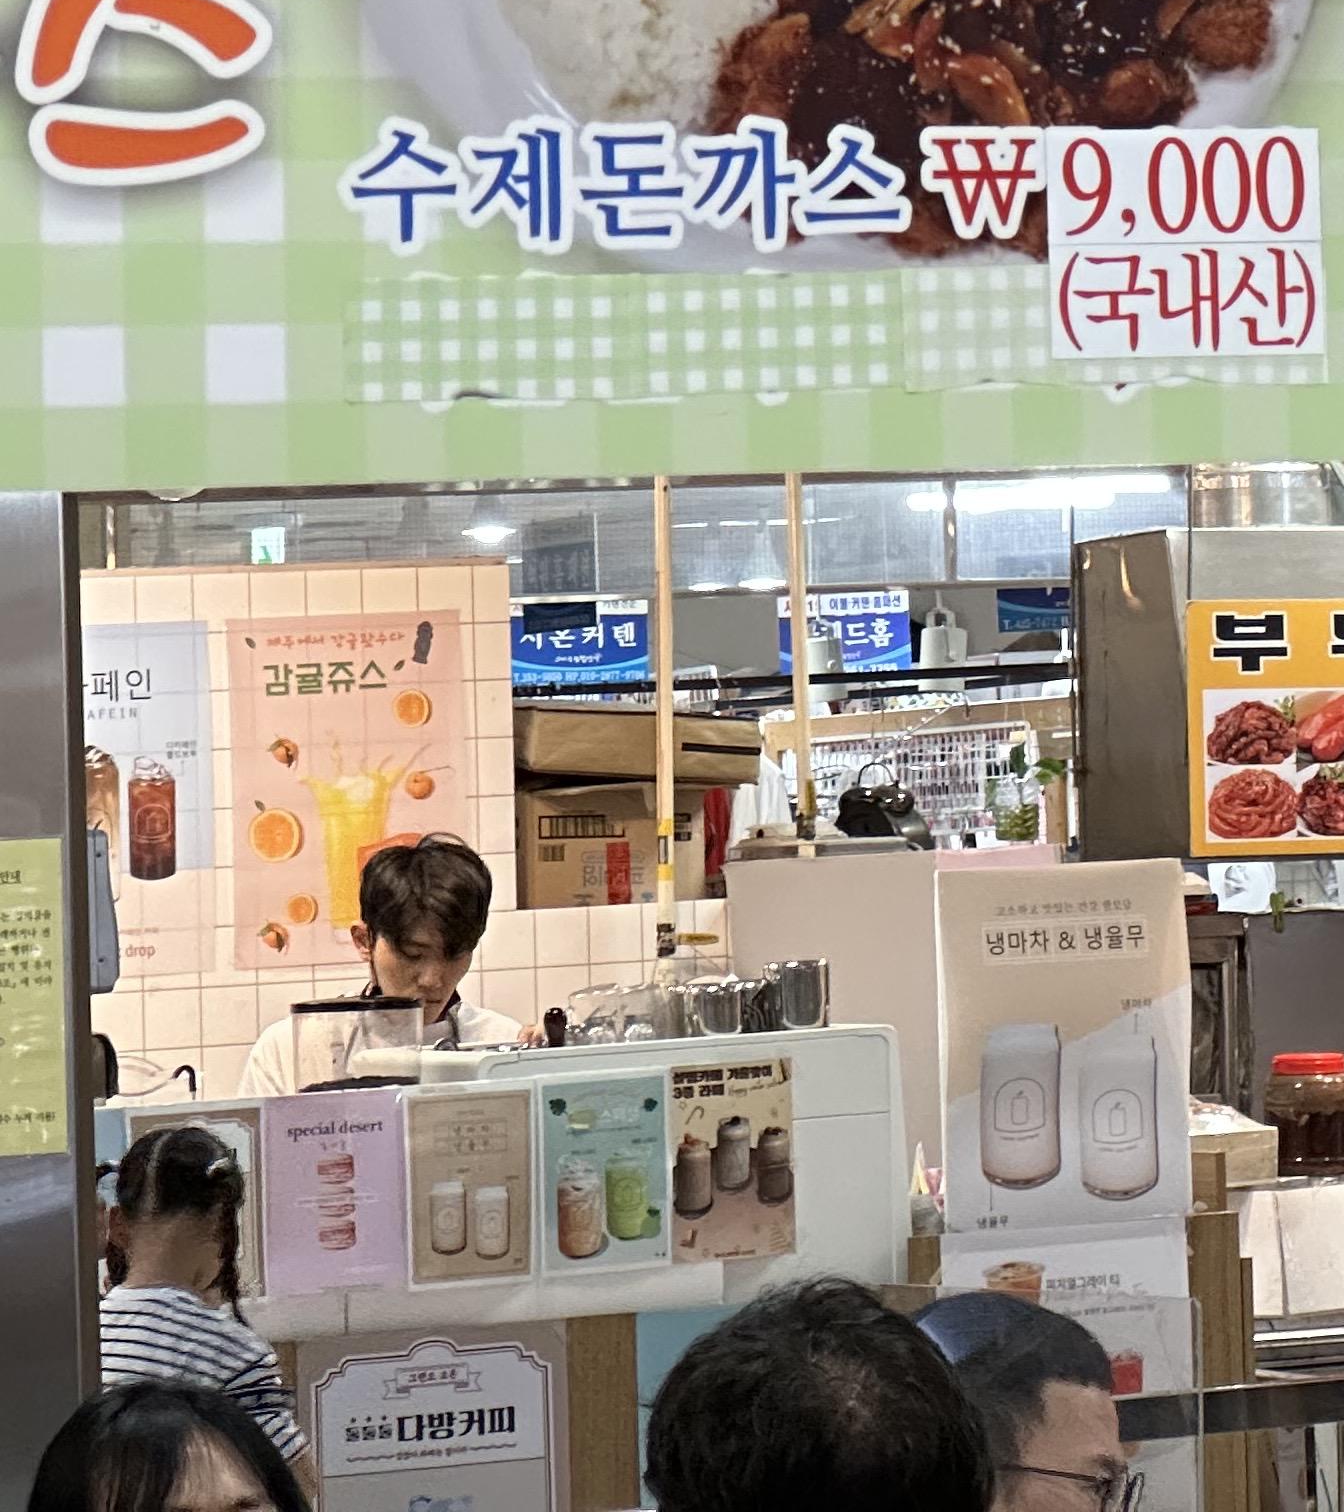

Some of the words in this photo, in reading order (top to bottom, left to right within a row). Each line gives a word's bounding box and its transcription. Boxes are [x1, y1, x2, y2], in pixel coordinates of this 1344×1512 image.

[350, 125, 904, 246] 수제돈까스
[1058, 247, 1317, 352] (국내산)
[82, 668, 152, 702] 페인
[263, 659, 387, 697] 감귤쥬스
[986, 930, 1050, 956] 냉마차
[1058, 930, 1076, 951] &
[1084, 924, 1145, 950] 냉율무
[287, 1122, 336, 1142] special
[339, 1120, 383, 1135] desert
[396, 1405, 516, 1443] 다방커피
